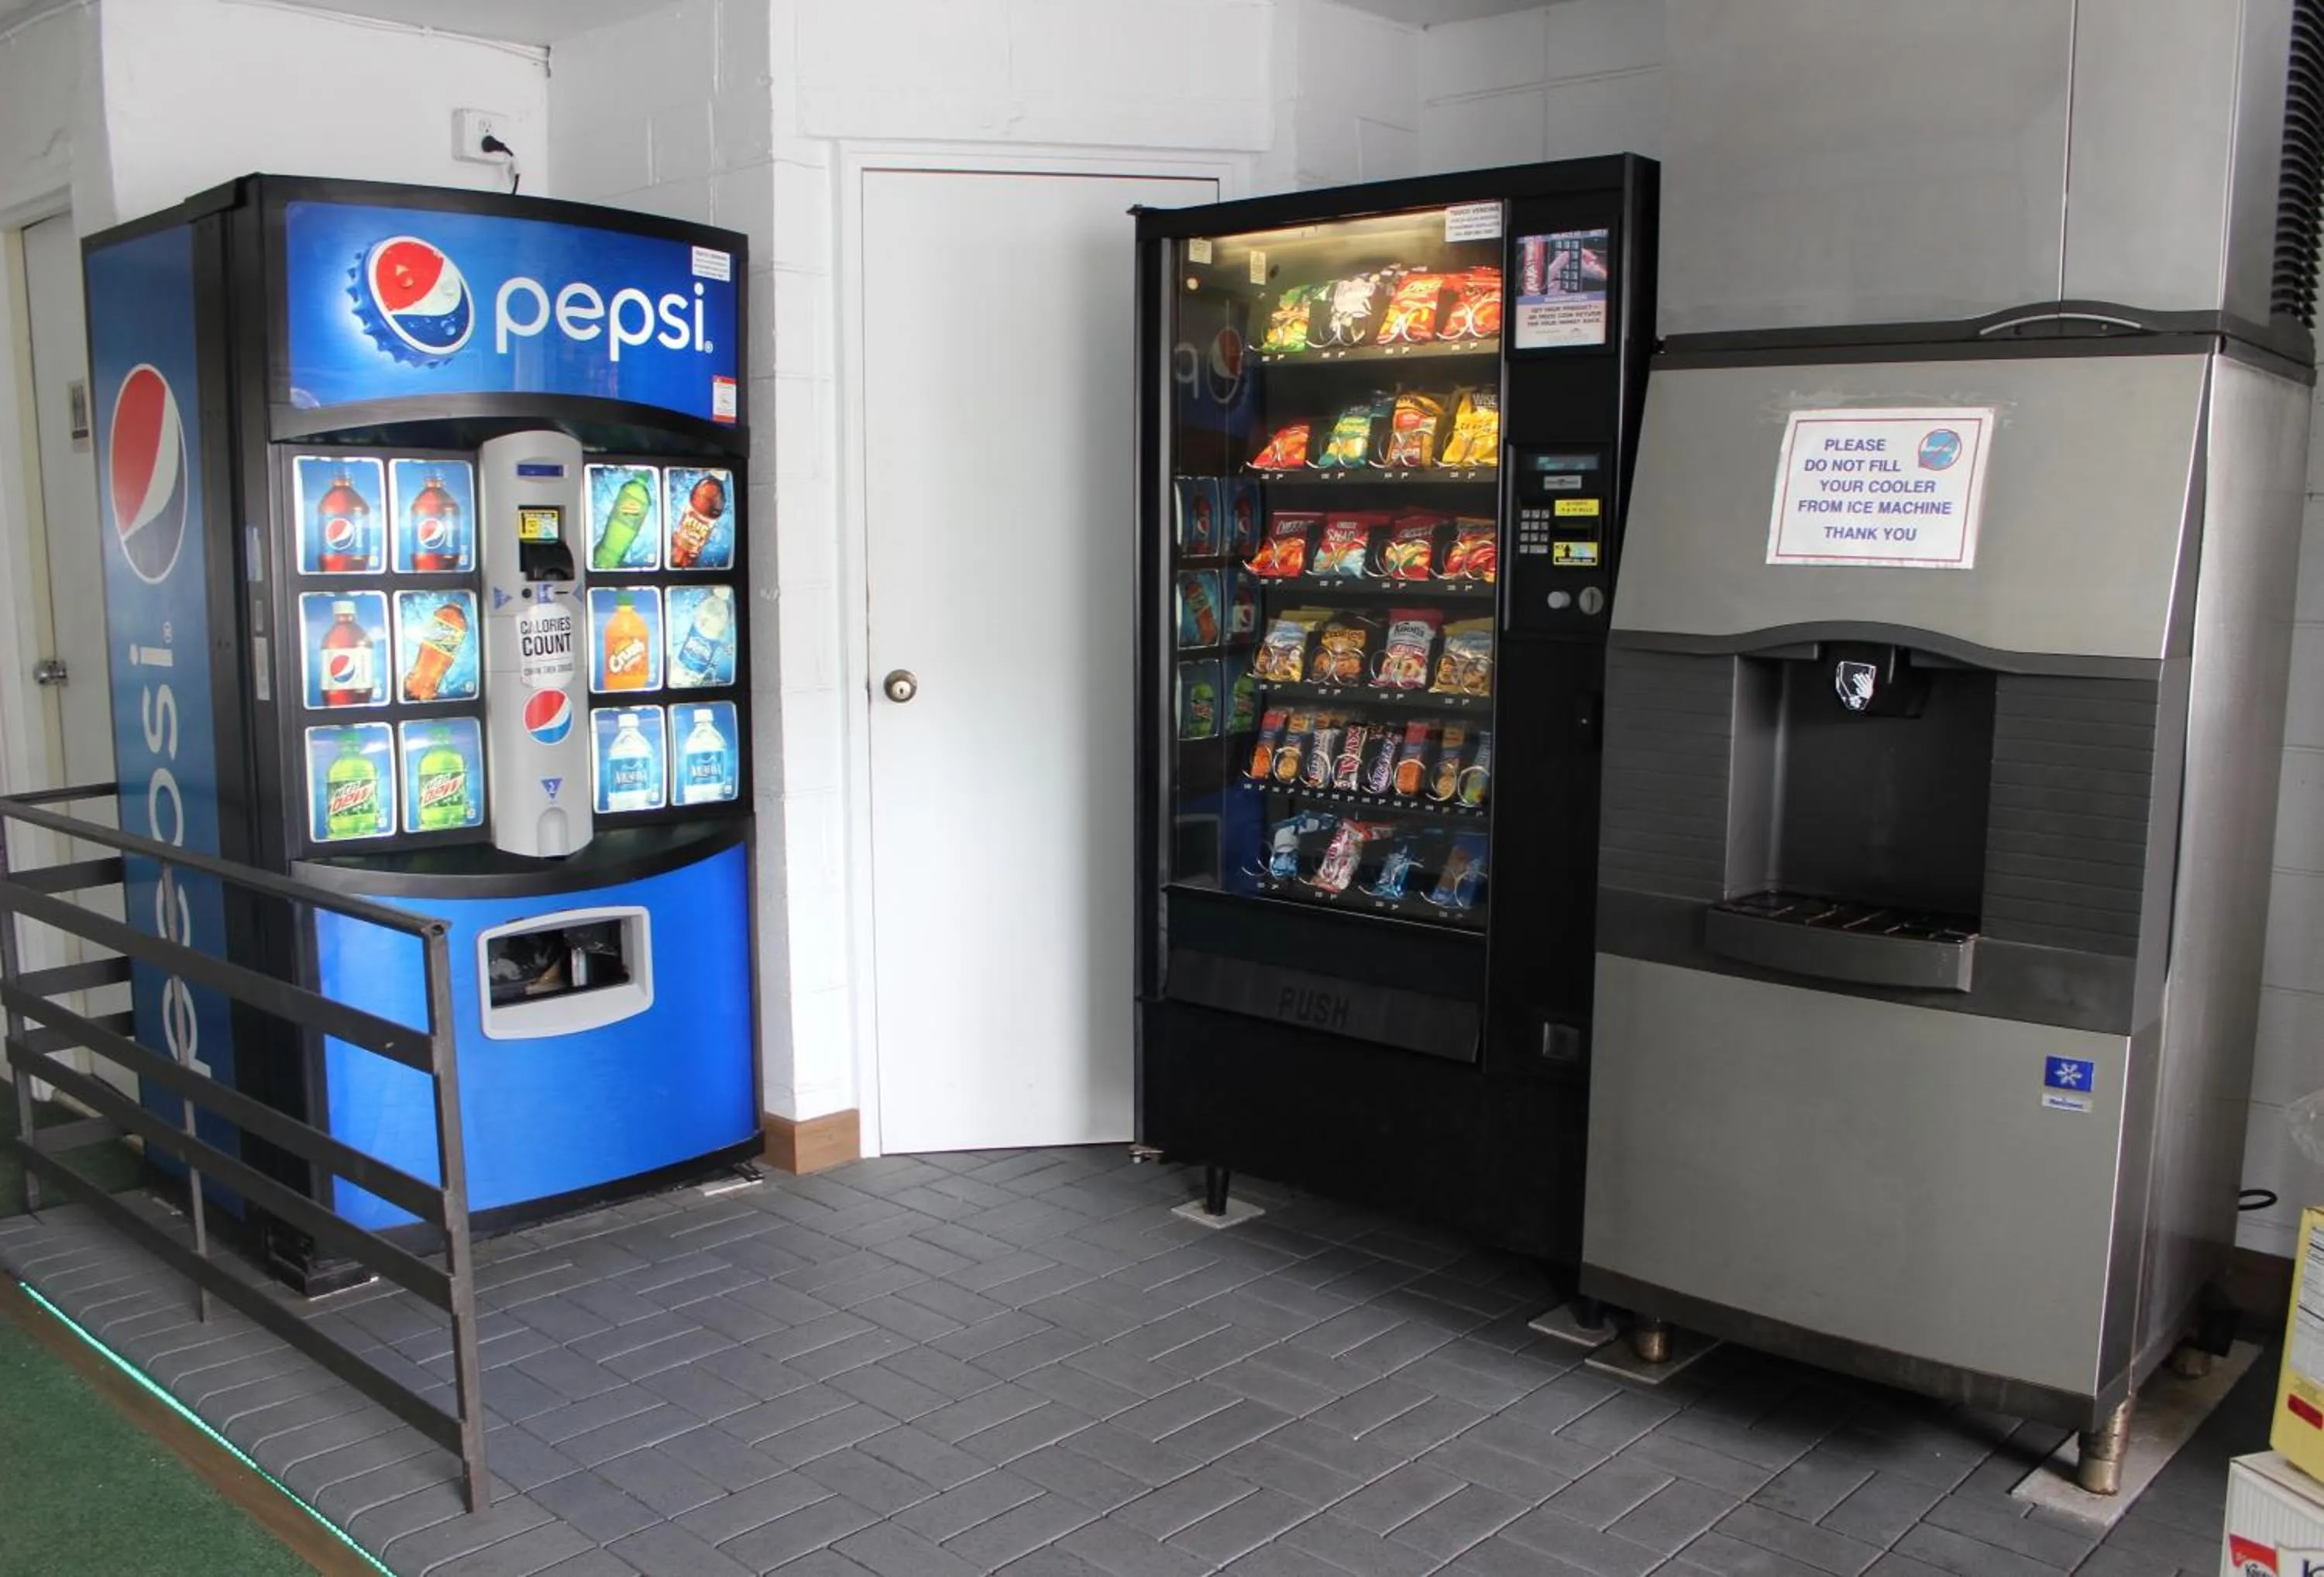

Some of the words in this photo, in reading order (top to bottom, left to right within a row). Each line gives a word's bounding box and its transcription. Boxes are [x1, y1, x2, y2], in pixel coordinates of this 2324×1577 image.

[495, 277, 704, 362] pepsi
[1824, 438, 1886, 452] PLEASE
[1804, 459, 1827, 472] DO
[1831, 459, 1865, 472] NOT
[1868, 460, 1902, 472] FILL
[1819, 479, 1863, 493] YOUR
[1868, 480, 1936, 493] COOLER
[1797, 500, 1843, 513] FROM
[1847, 501, 1872, 514] ICE
[1877, 501, 1952, 515] MACHINE
[1824, 526, 1878, 540] THANK
[1883, 527, 1917, 541] YOU
[520, 617, 571, 634] CALORIES
[522, 633, 571, 657] COUNT
[609, 638, 645, 674] Crush
[1278, 986, 1349, 1029] PUSH
